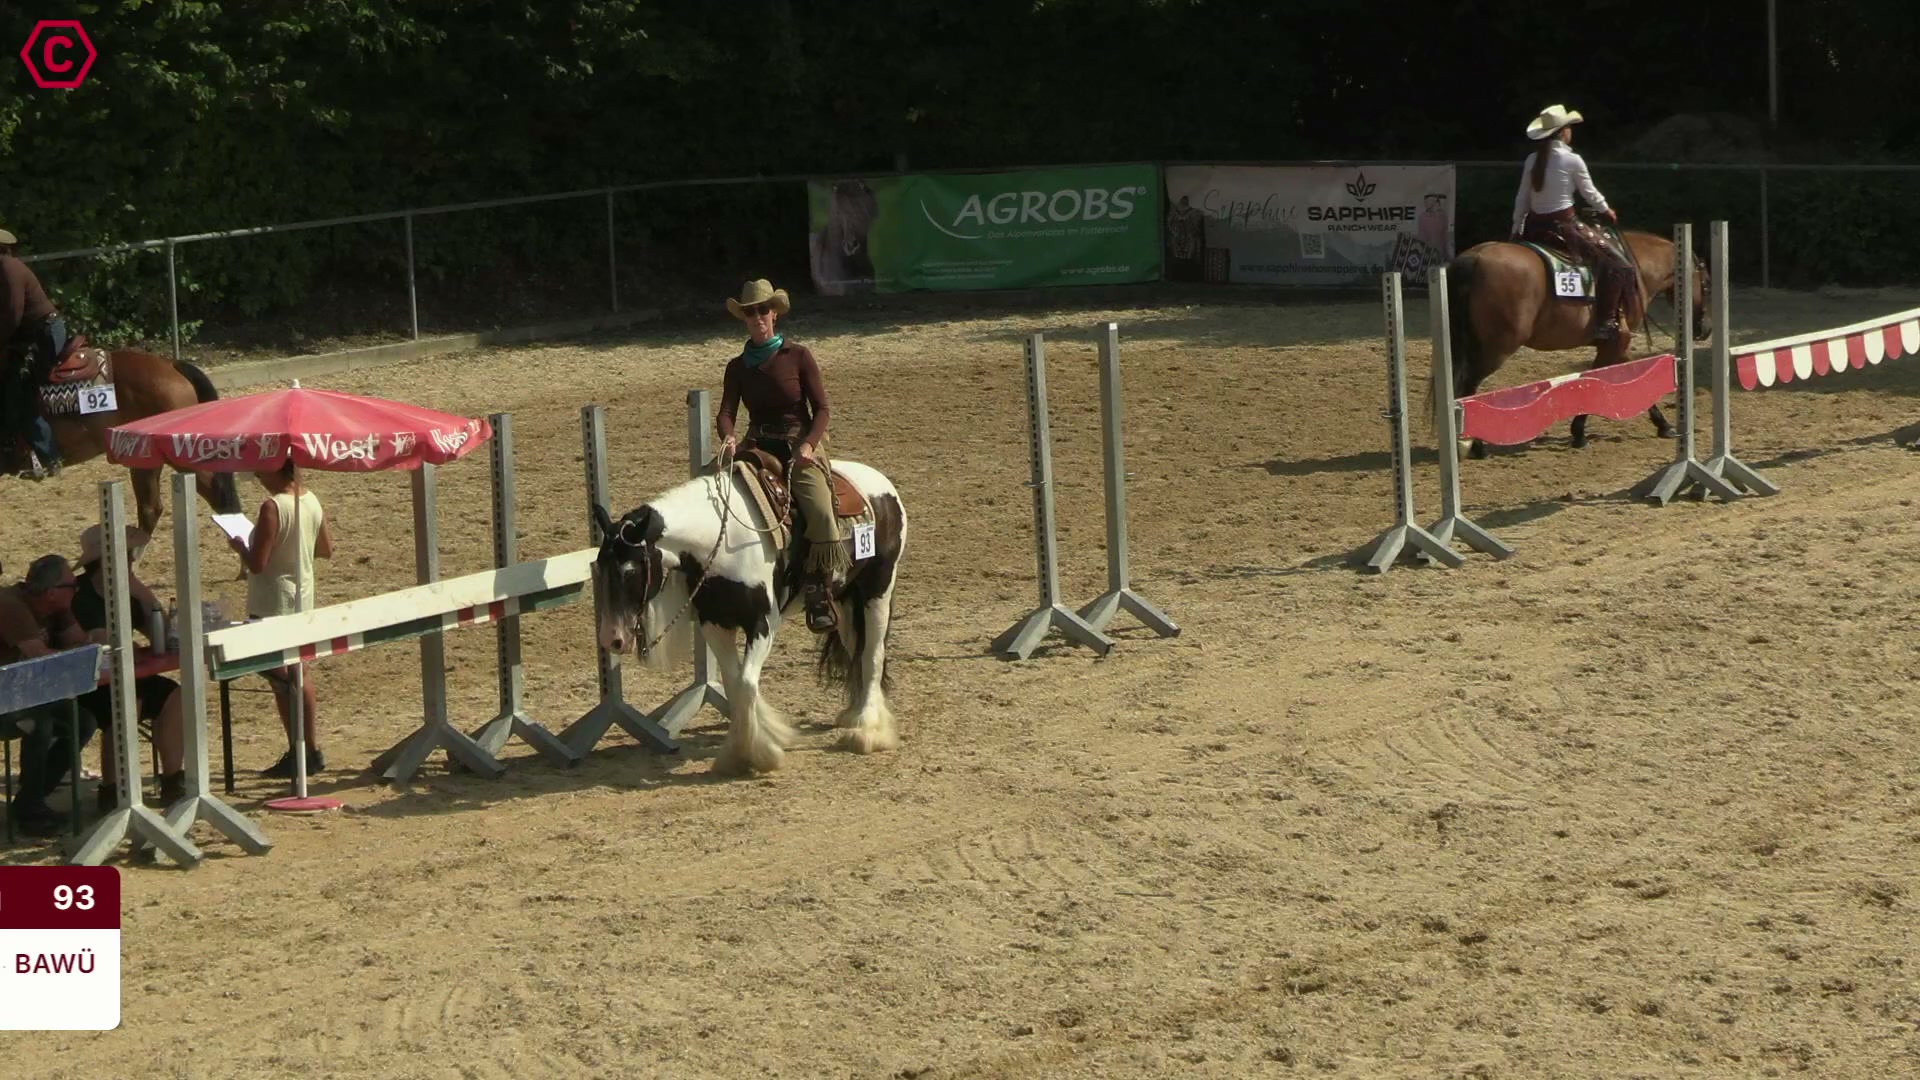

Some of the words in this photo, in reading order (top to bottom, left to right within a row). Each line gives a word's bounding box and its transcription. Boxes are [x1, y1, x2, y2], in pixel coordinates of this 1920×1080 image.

[1307, 206, 1417, 222] SAPPHIRE
[1561, 277, 1576, 293] 55
[87, 392, 109, 409] 92
[171, 432, 247, 462] West
[301, 432, 379, 464] West
[860, 533, 871, 554] 93
